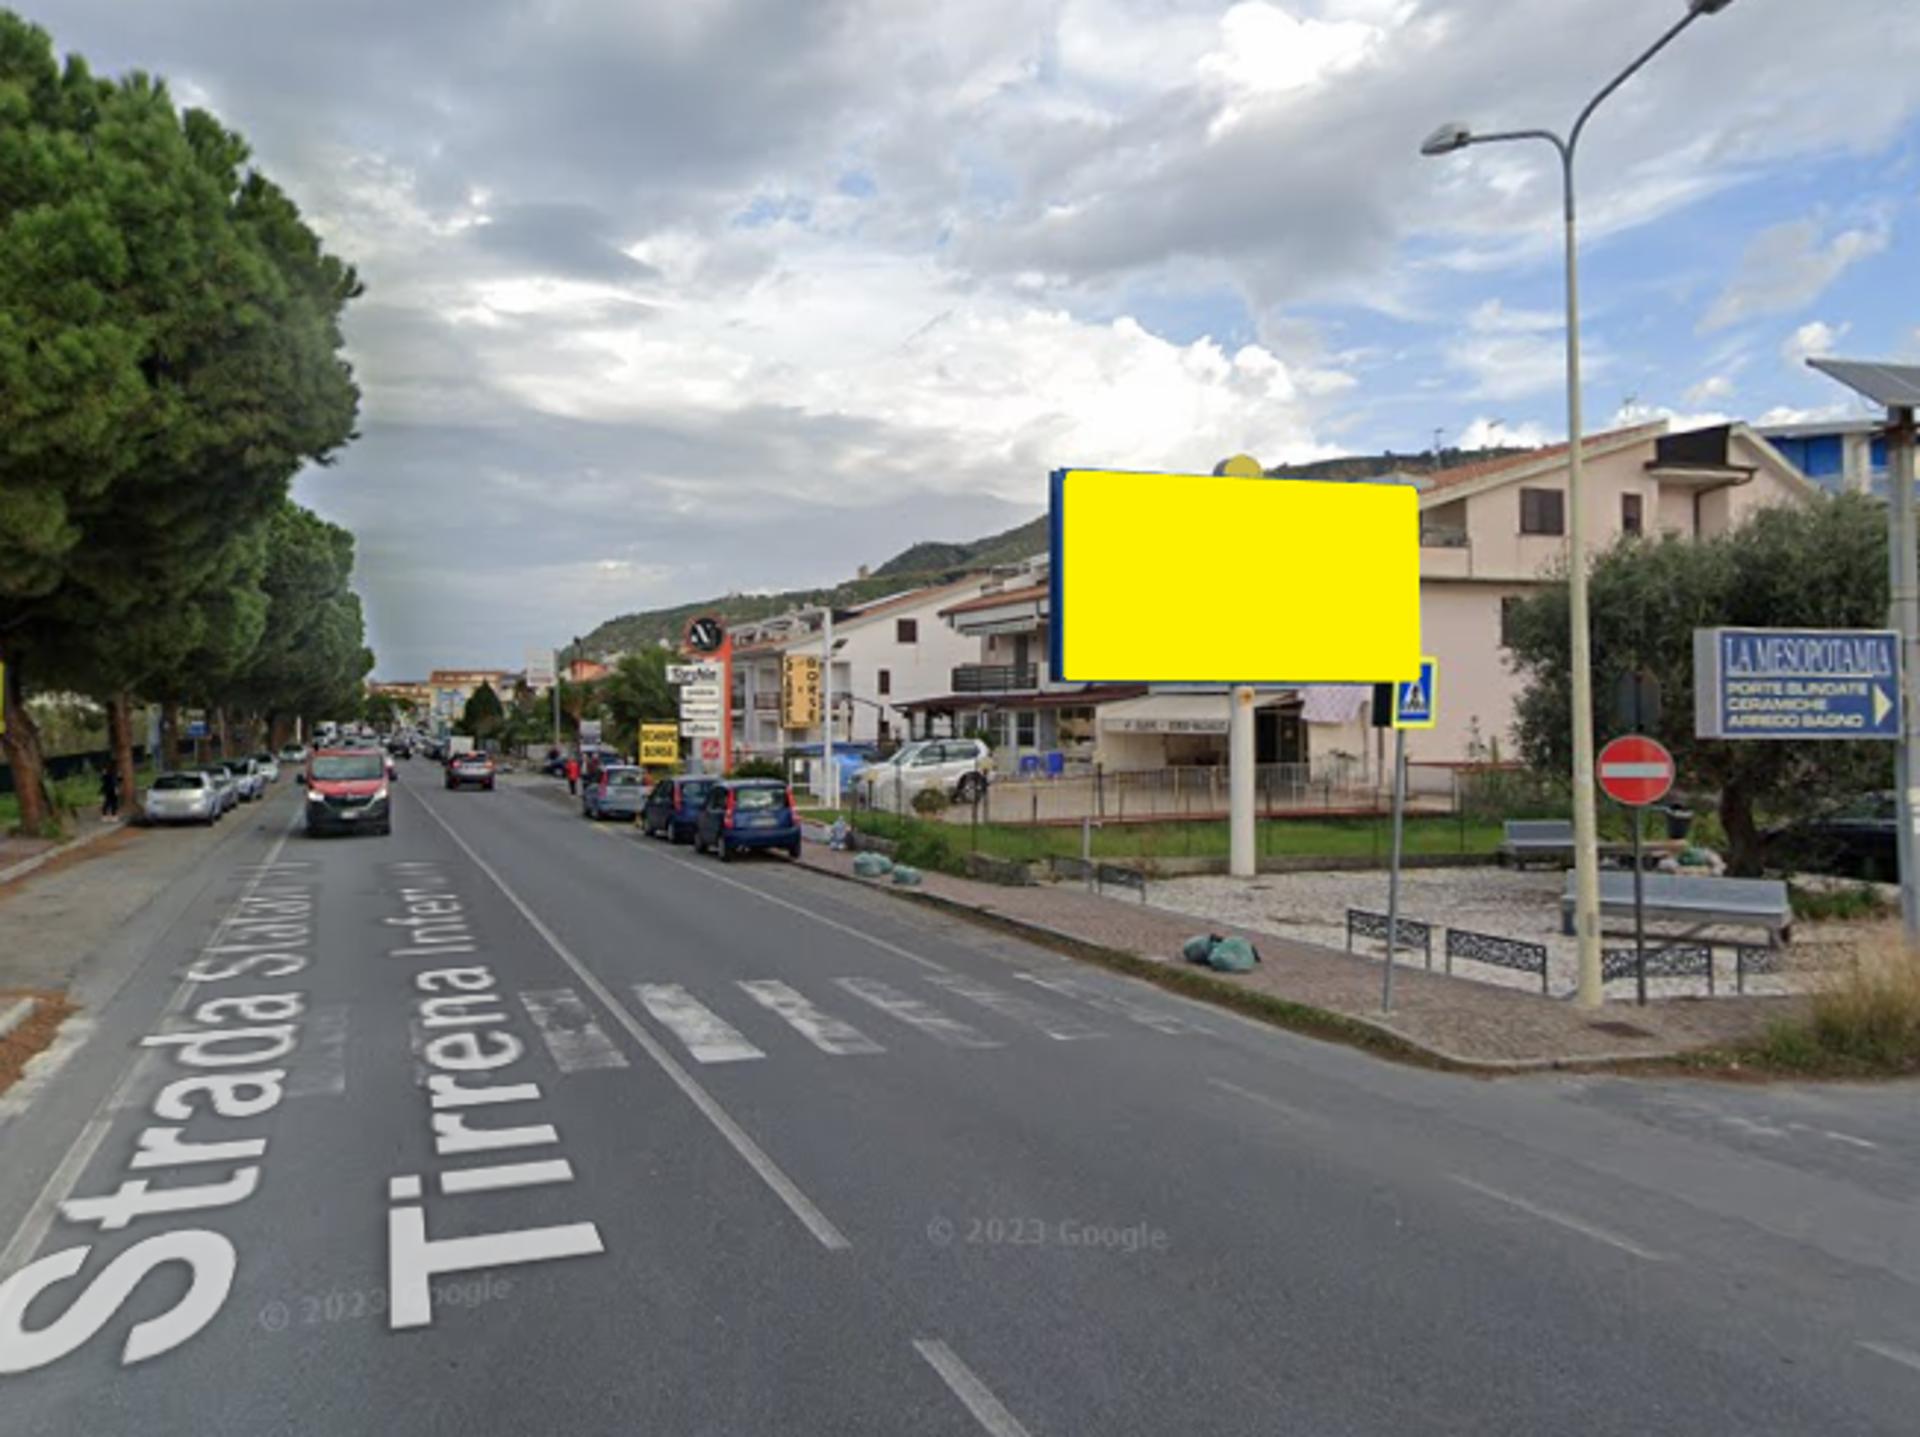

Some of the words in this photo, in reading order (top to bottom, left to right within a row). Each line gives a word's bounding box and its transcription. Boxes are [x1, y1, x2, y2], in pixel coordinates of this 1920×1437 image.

[1725, 637, 1753, 672] LA
[1755, 638, 1892, 677] MESOPOTAMIA
[1726, 682, 1783, 695] PORTE
[1727, 697, 1828, 710] CERAMICHE
[1802, 714, 1865, 728] BAGNO
